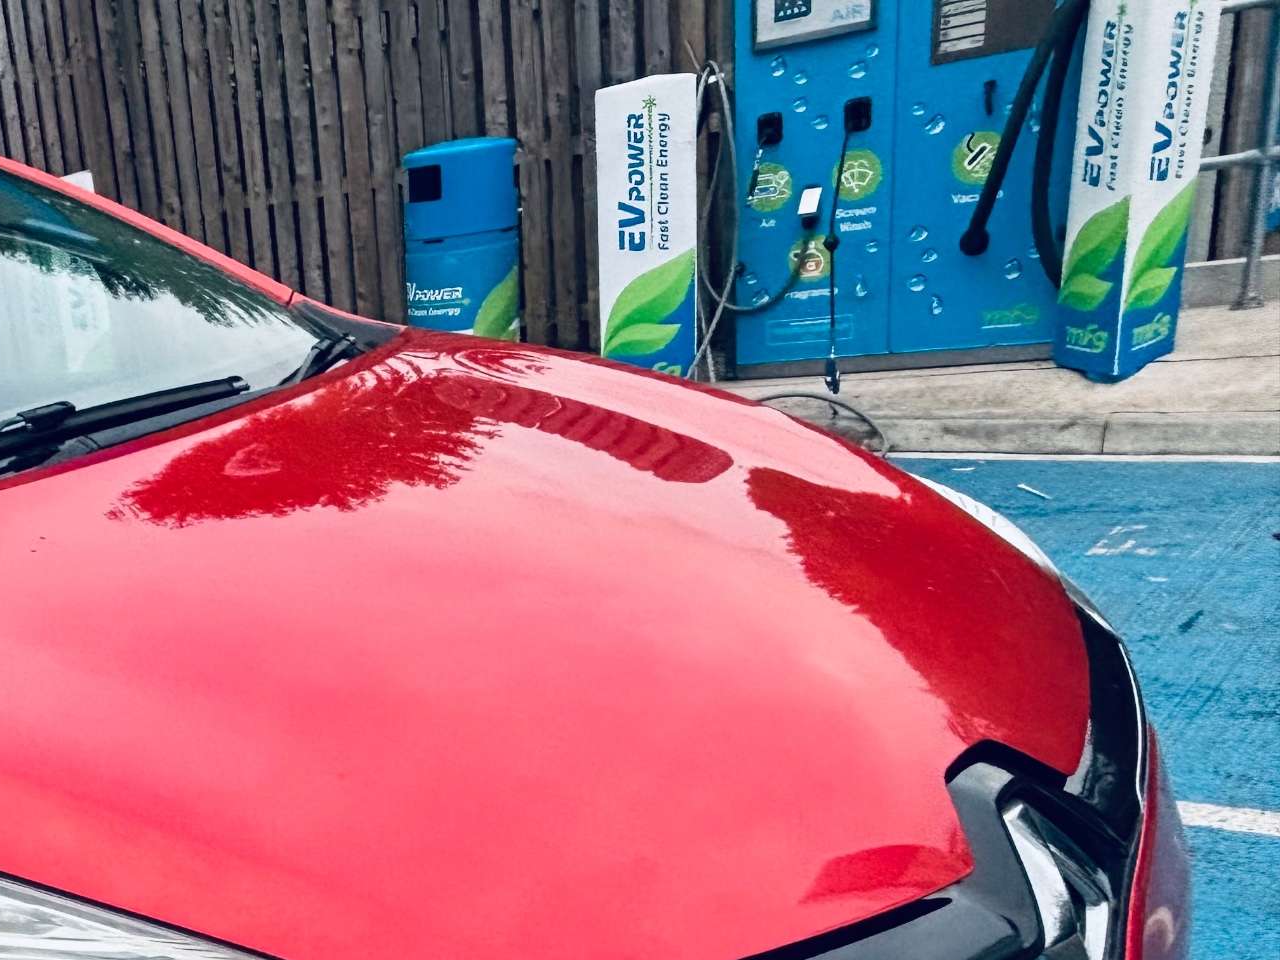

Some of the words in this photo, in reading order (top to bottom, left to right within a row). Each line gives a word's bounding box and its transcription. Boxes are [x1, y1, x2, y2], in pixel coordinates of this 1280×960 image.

[656, 113, 671, 170] Energy
[657, 173, 670, 217] Clean
[657, 222, 670, 251] Fast
